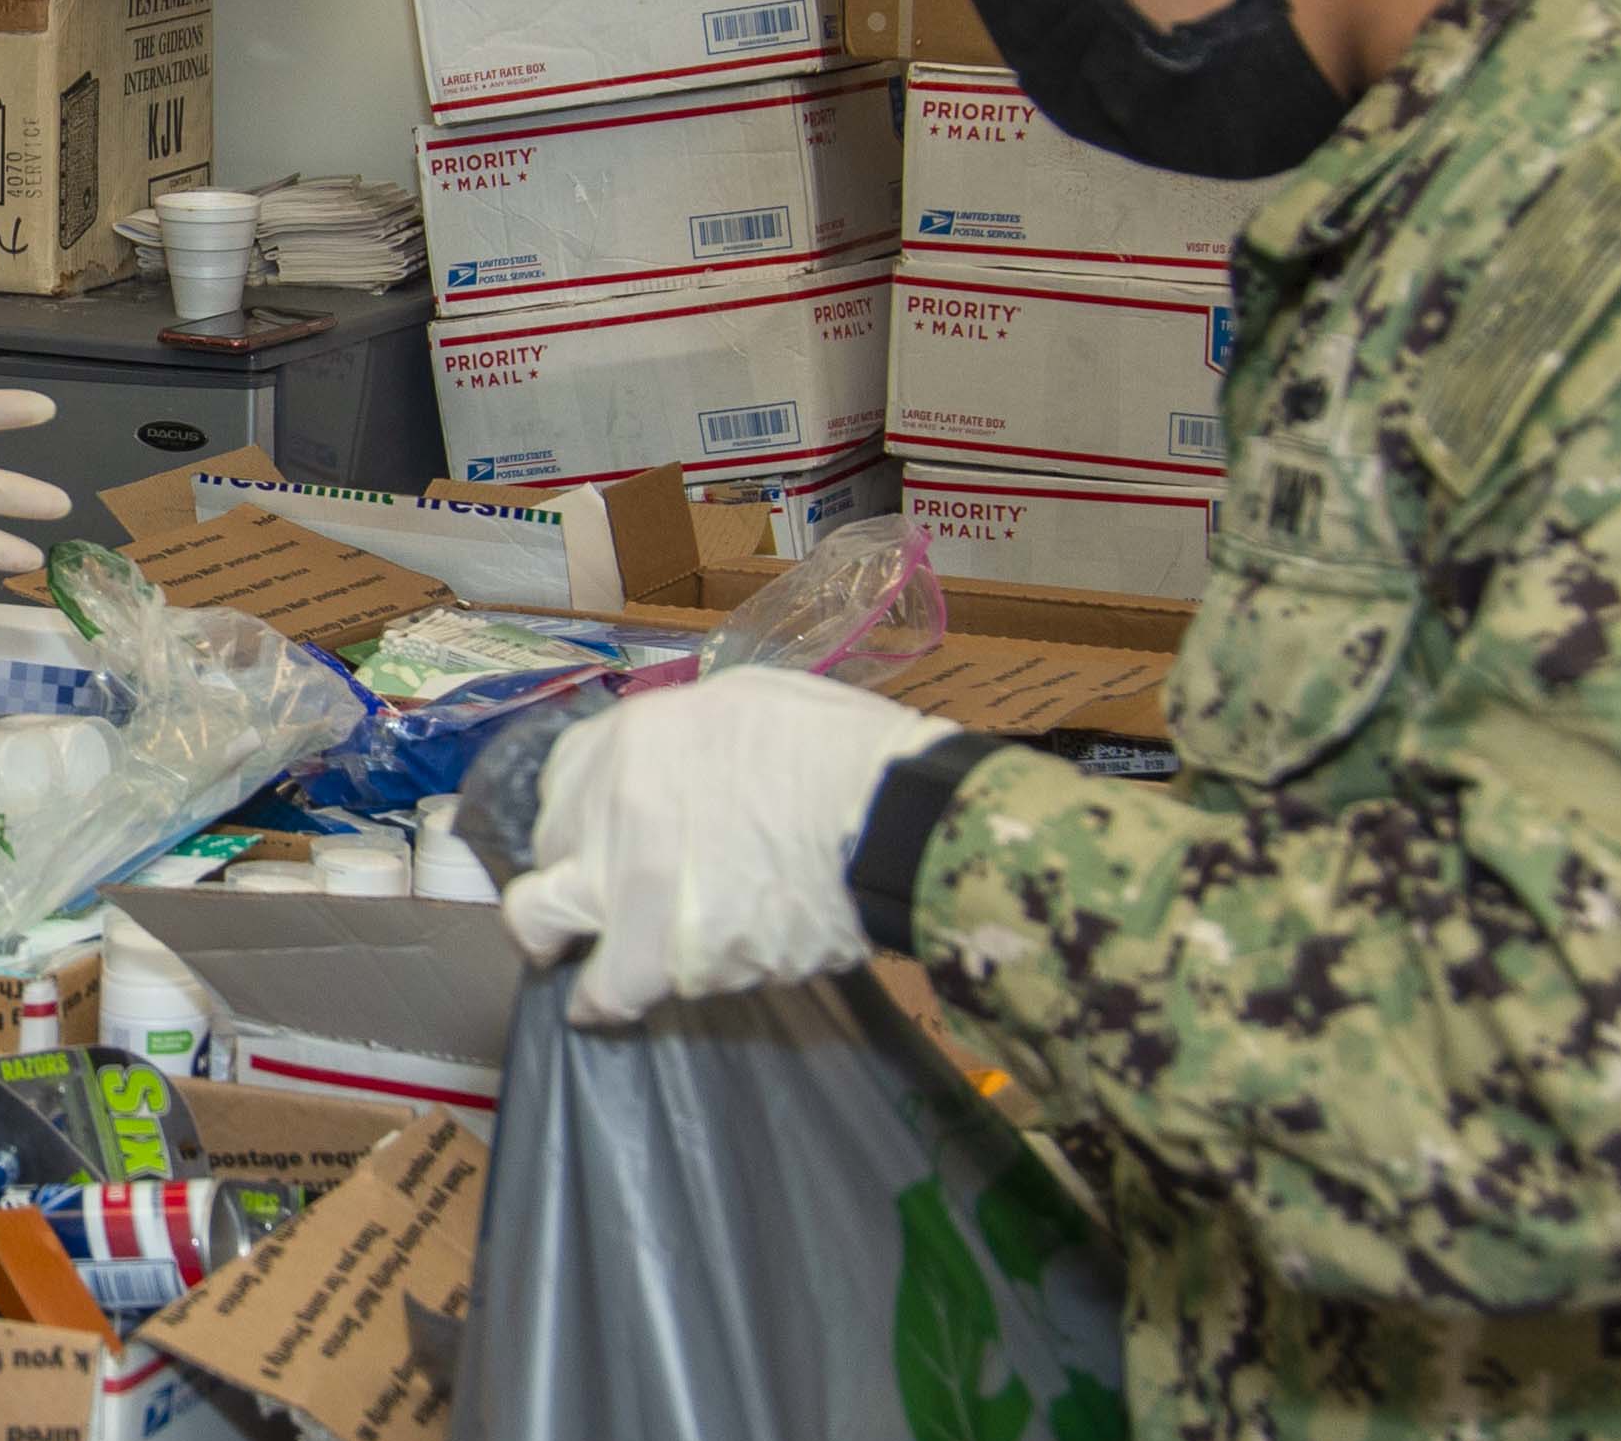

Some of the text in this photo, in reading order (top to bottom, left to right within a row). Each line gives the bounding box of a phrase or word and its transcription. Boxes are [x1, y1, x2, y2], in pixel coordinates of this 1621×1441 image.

[134, 24, 204, 61] THE GIDEONS
[124, 53, 211, 97] INTERNATIONAL
[441, 74, 472, 88] LARGE
[473, 69, 497, 84] FLAT
[499, 65, 523, 80] RATE
[525, 63, 547, 76] BOX
[922, 101, 1036, 124] PRIORITY
[148, 96, 185, 160] KJV
[948, 125, 1006, 142] MAIL
[24, 116, 43, 199] SERVICE
[431, 149, 534, 176] PRIORITY
[458, 173, 511, 192] MAIL
[1185, 242, 1226, 255] VISIT US
[814, 298, 872, 324] PRIORITY
[908, 296, 1017, 322] PRIORITY
[833, 321, 865, 341] MAIL
[932, 321, 988, 340] MAIL
[445, 346, 544, 373] PRIORITY
[471, 369, 523, 389] MAIL
[902, 409, 933, 423] LARGE
[934, 412, 957, 424] FLAT
[958, 415, 984, 427] RATE
[985, 417, 1006, 430] BOX
[146, 427, 200, 443] DACUS
[914, 499, 1024, 523] PRIORITY
[939, 523, 996, 541] MAIL
[2, 1052, 70, 1082] RAZORS
[99, 1063, 173, 1180] SIX
[13, 1349, 65, 1370] you
